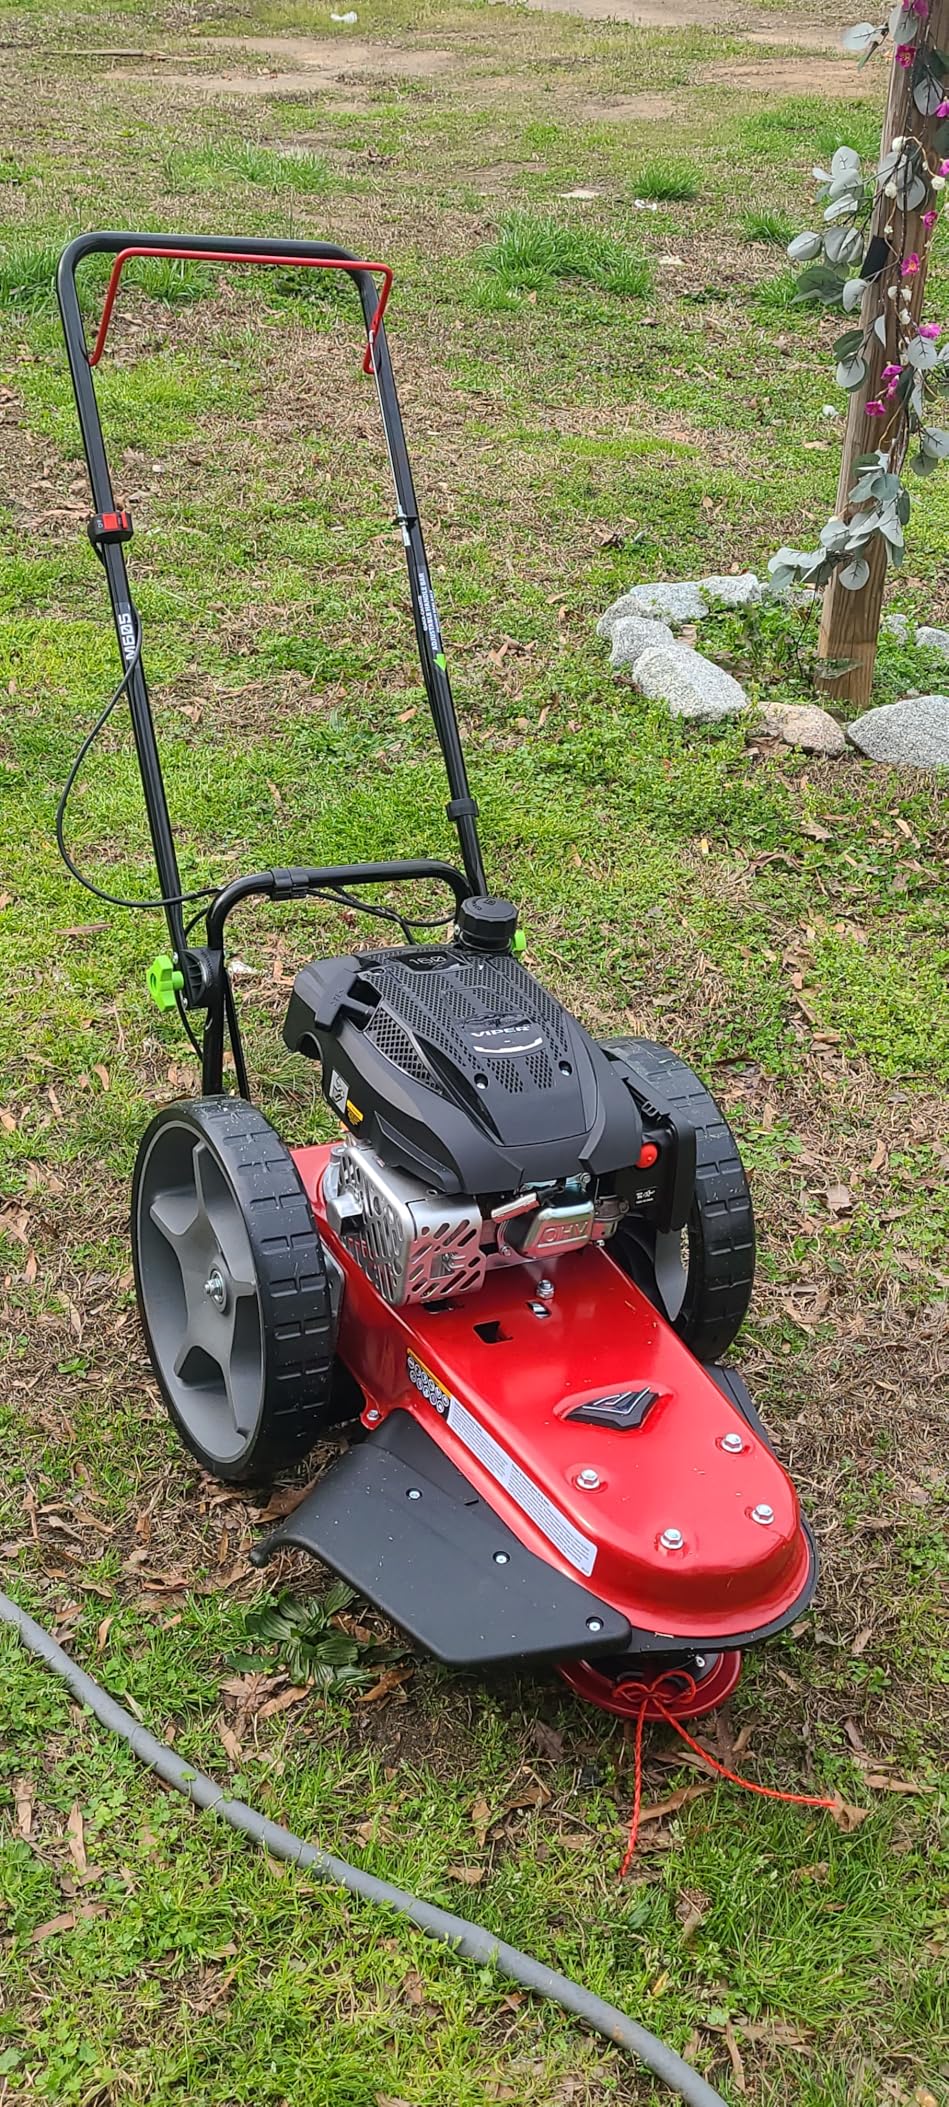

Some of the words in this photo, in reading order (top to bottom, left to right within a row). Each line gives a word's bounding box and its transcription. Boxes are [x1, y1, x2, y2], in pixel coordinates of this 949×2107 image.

[418, 572, 426, 585] BAR
[421, 586, 431, 612] HANDLE
[118, 613, 136, 660] M605
[426, 612, 438, 650] ADJUSTABLE
[409, 955, 446, 965] 160
[471, 1026, 530, 1037] VIPER
[542, 1221, 588, 1242] OHV
